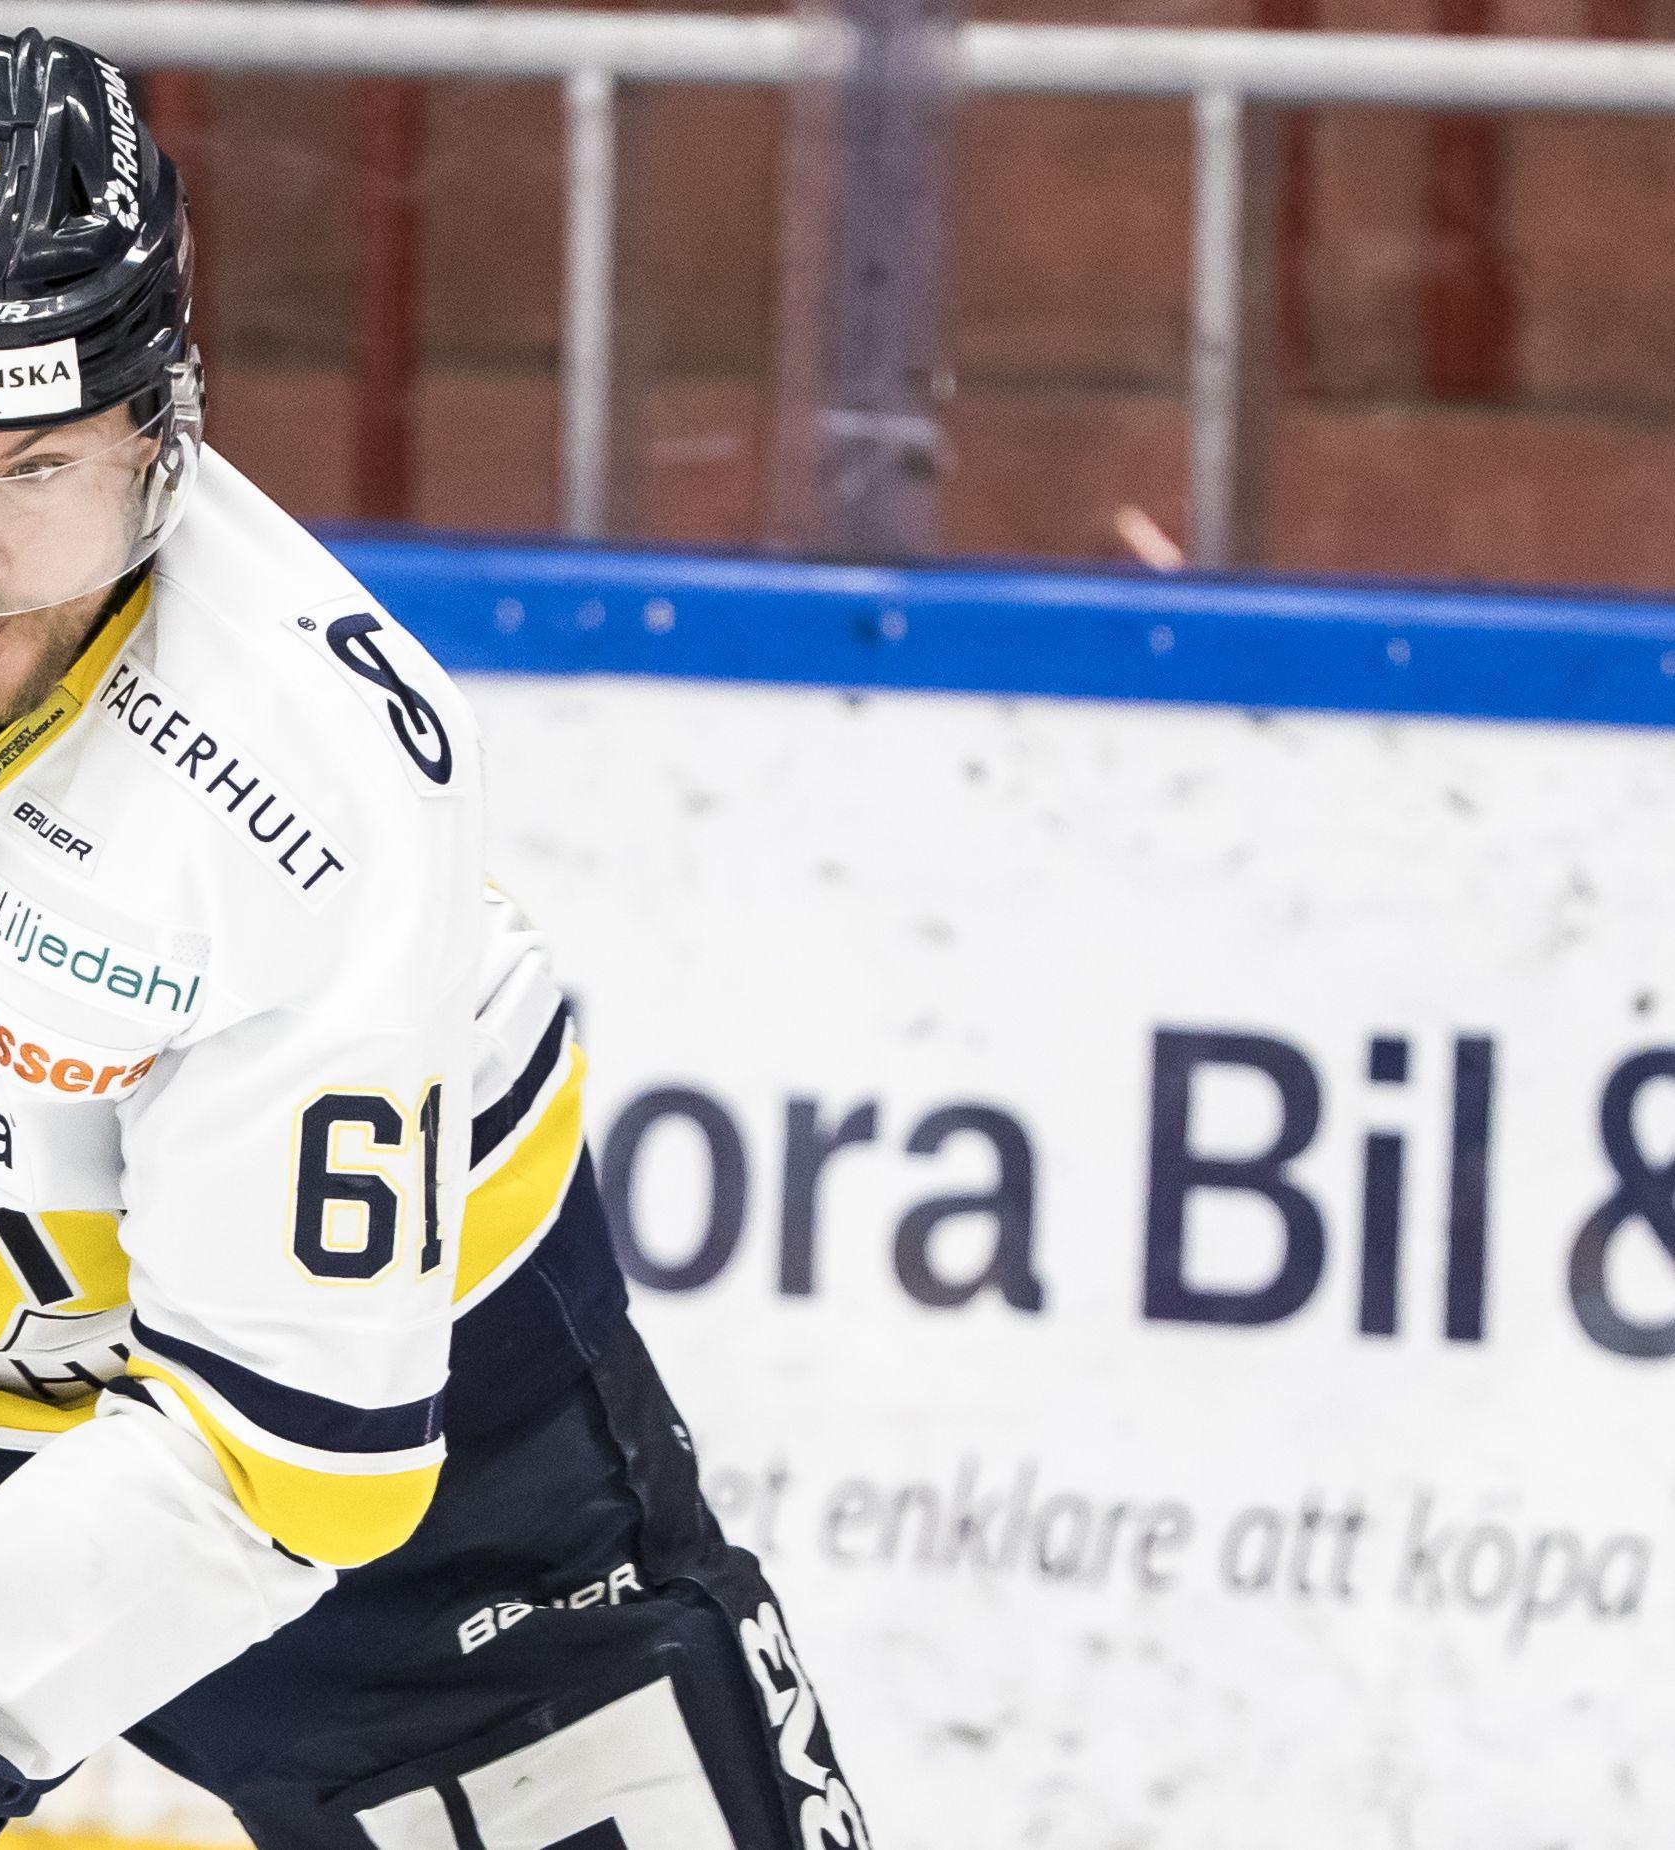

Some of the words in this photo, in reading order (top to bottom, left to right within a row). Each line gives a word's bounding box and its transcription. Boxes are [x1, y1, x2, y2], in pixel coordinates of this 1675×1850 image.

[0, 707, 66, 770] ALLSVENSKAN
[13, 801, 94, 862] BAUER
[98, 663, 345, 891] FAGERHULT
[292, 1082, 444, 1280] 61
[598, 1082, 1048, 1316] ora
[1140, 1021, 1498, 1344] Bil
[457, 1561, 645, 1655] BAER
[819, 1453, 1198, 1592] enklare
[1220, 1487, 1376, 1601] att
[1404, 1485, 1655, 1653] köpa
